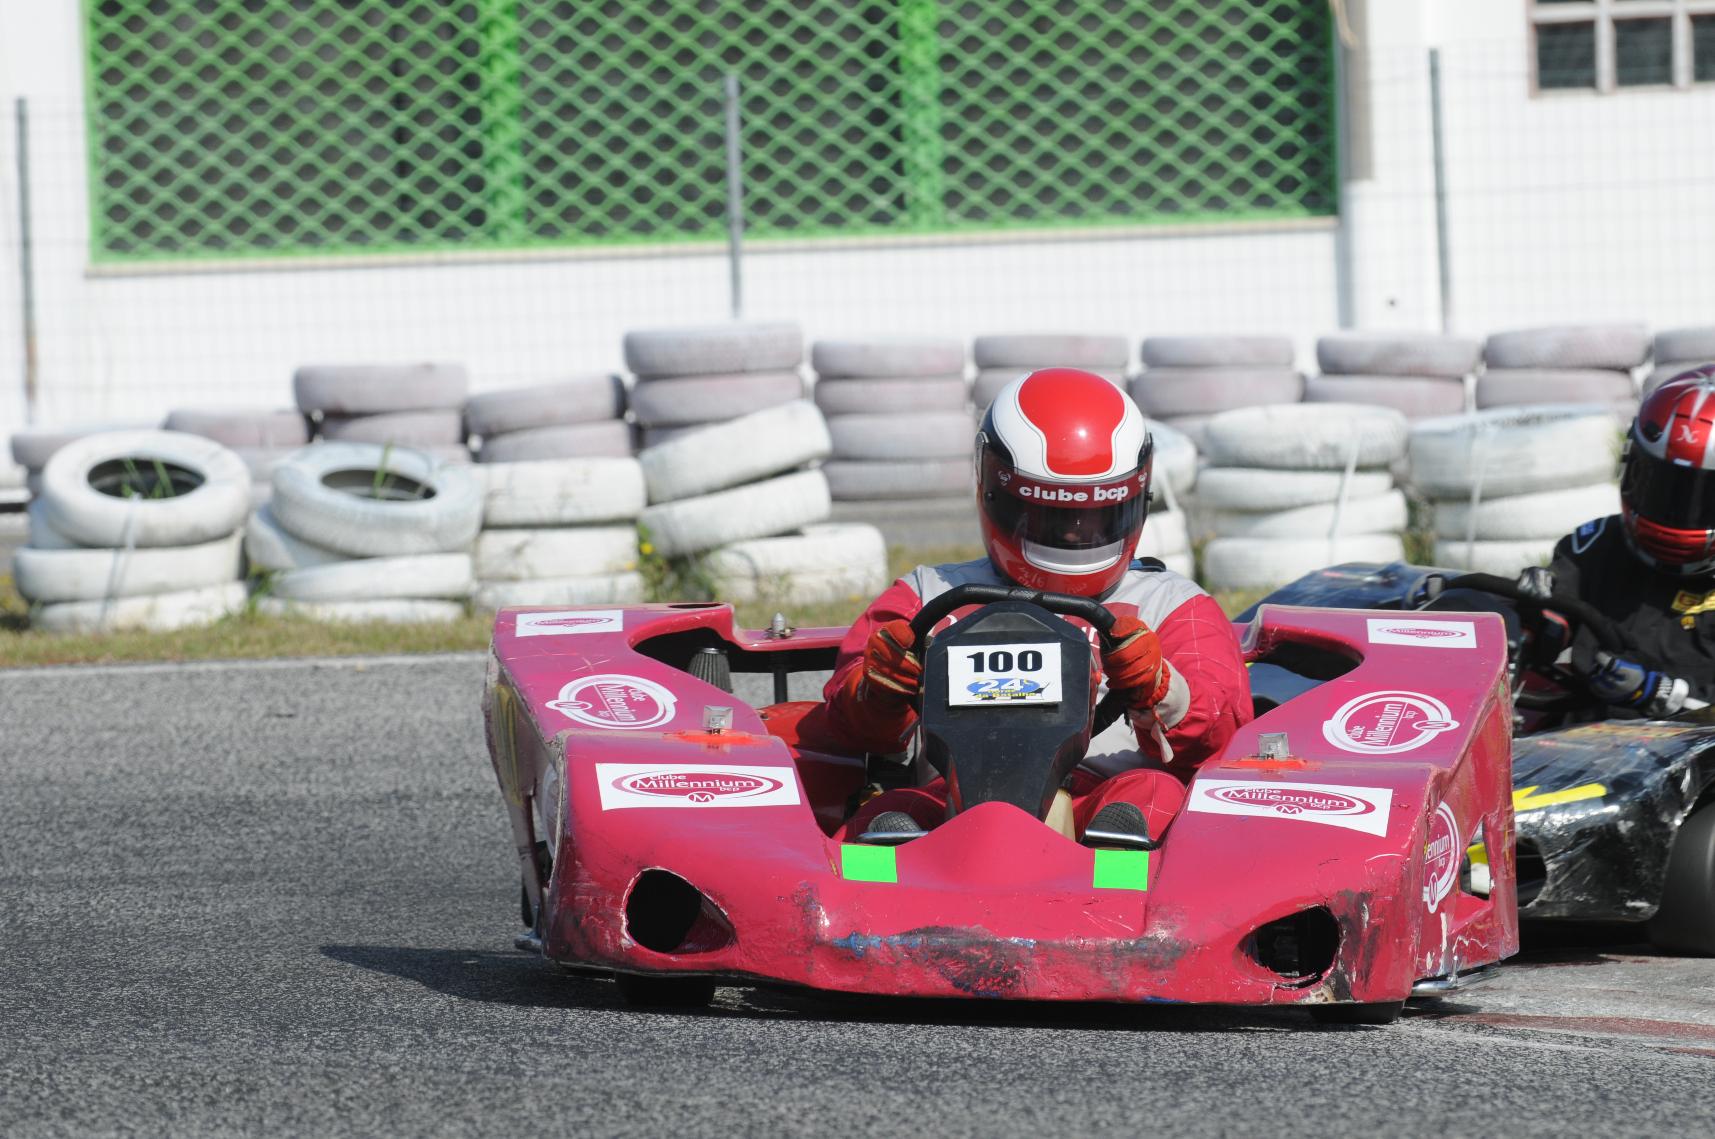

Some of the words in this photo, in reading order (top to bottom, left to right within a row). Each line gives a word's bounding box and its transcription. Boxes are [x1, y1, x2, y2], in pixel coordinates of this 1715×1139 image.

[1019, 486, 1088, 502] clube
[1094, 485, 1129, 502] bcp
[966, 650, 1043, 673] 100
[977, 678, 1024, 693] 24
[597, 684, 637, 721] Millennium
[1359, 703, 1403, 746] Millennium
[636, 779, 756, 788] Millennium
[1228, 790, 1348, 807] Millennium
